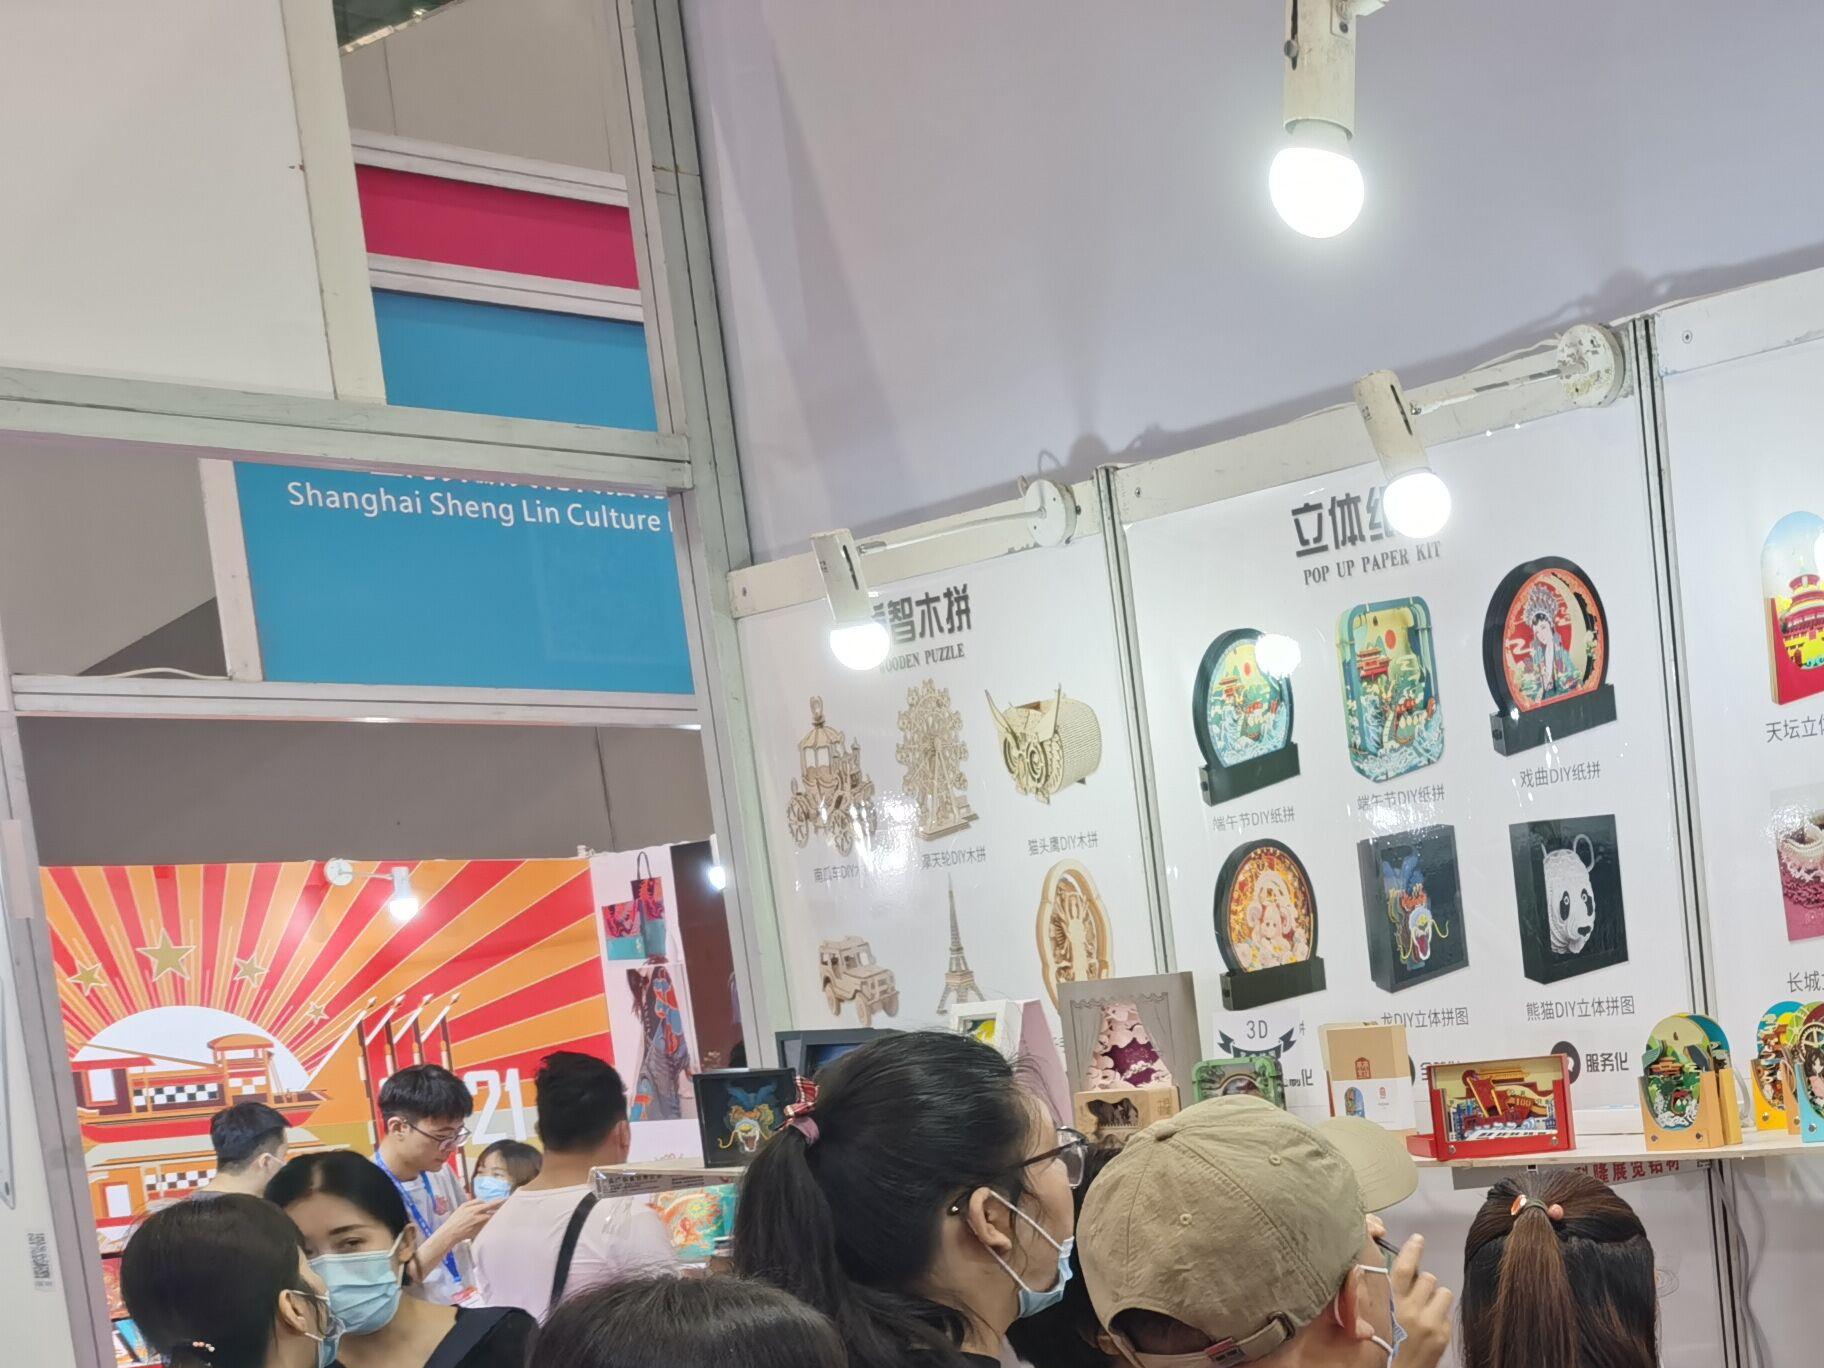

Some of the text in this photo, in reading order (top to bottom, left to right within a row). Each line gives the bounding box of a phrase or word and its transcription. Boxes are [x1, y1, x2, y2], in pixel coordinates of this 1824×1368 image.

[287, 481, 421, 517] Shanghai
[431, 492, 514, 527] Sheng
[523, 499, 560, 524] Lin
[567, 504, 661, 532] Culture
[1303, 541, 1441, 585] POP UP PAPER KIT
[924, 643, 965, 665] PUZZLE
[1519, 762, 1601, 789] 戏曲DIY纸拼
[1526, 995, 1635, 1022] 熊猫DIY立体拼图
[1246, 1020, 1268, 1039] 3D
[1585, 1052, 1630, 1073] 服务化
